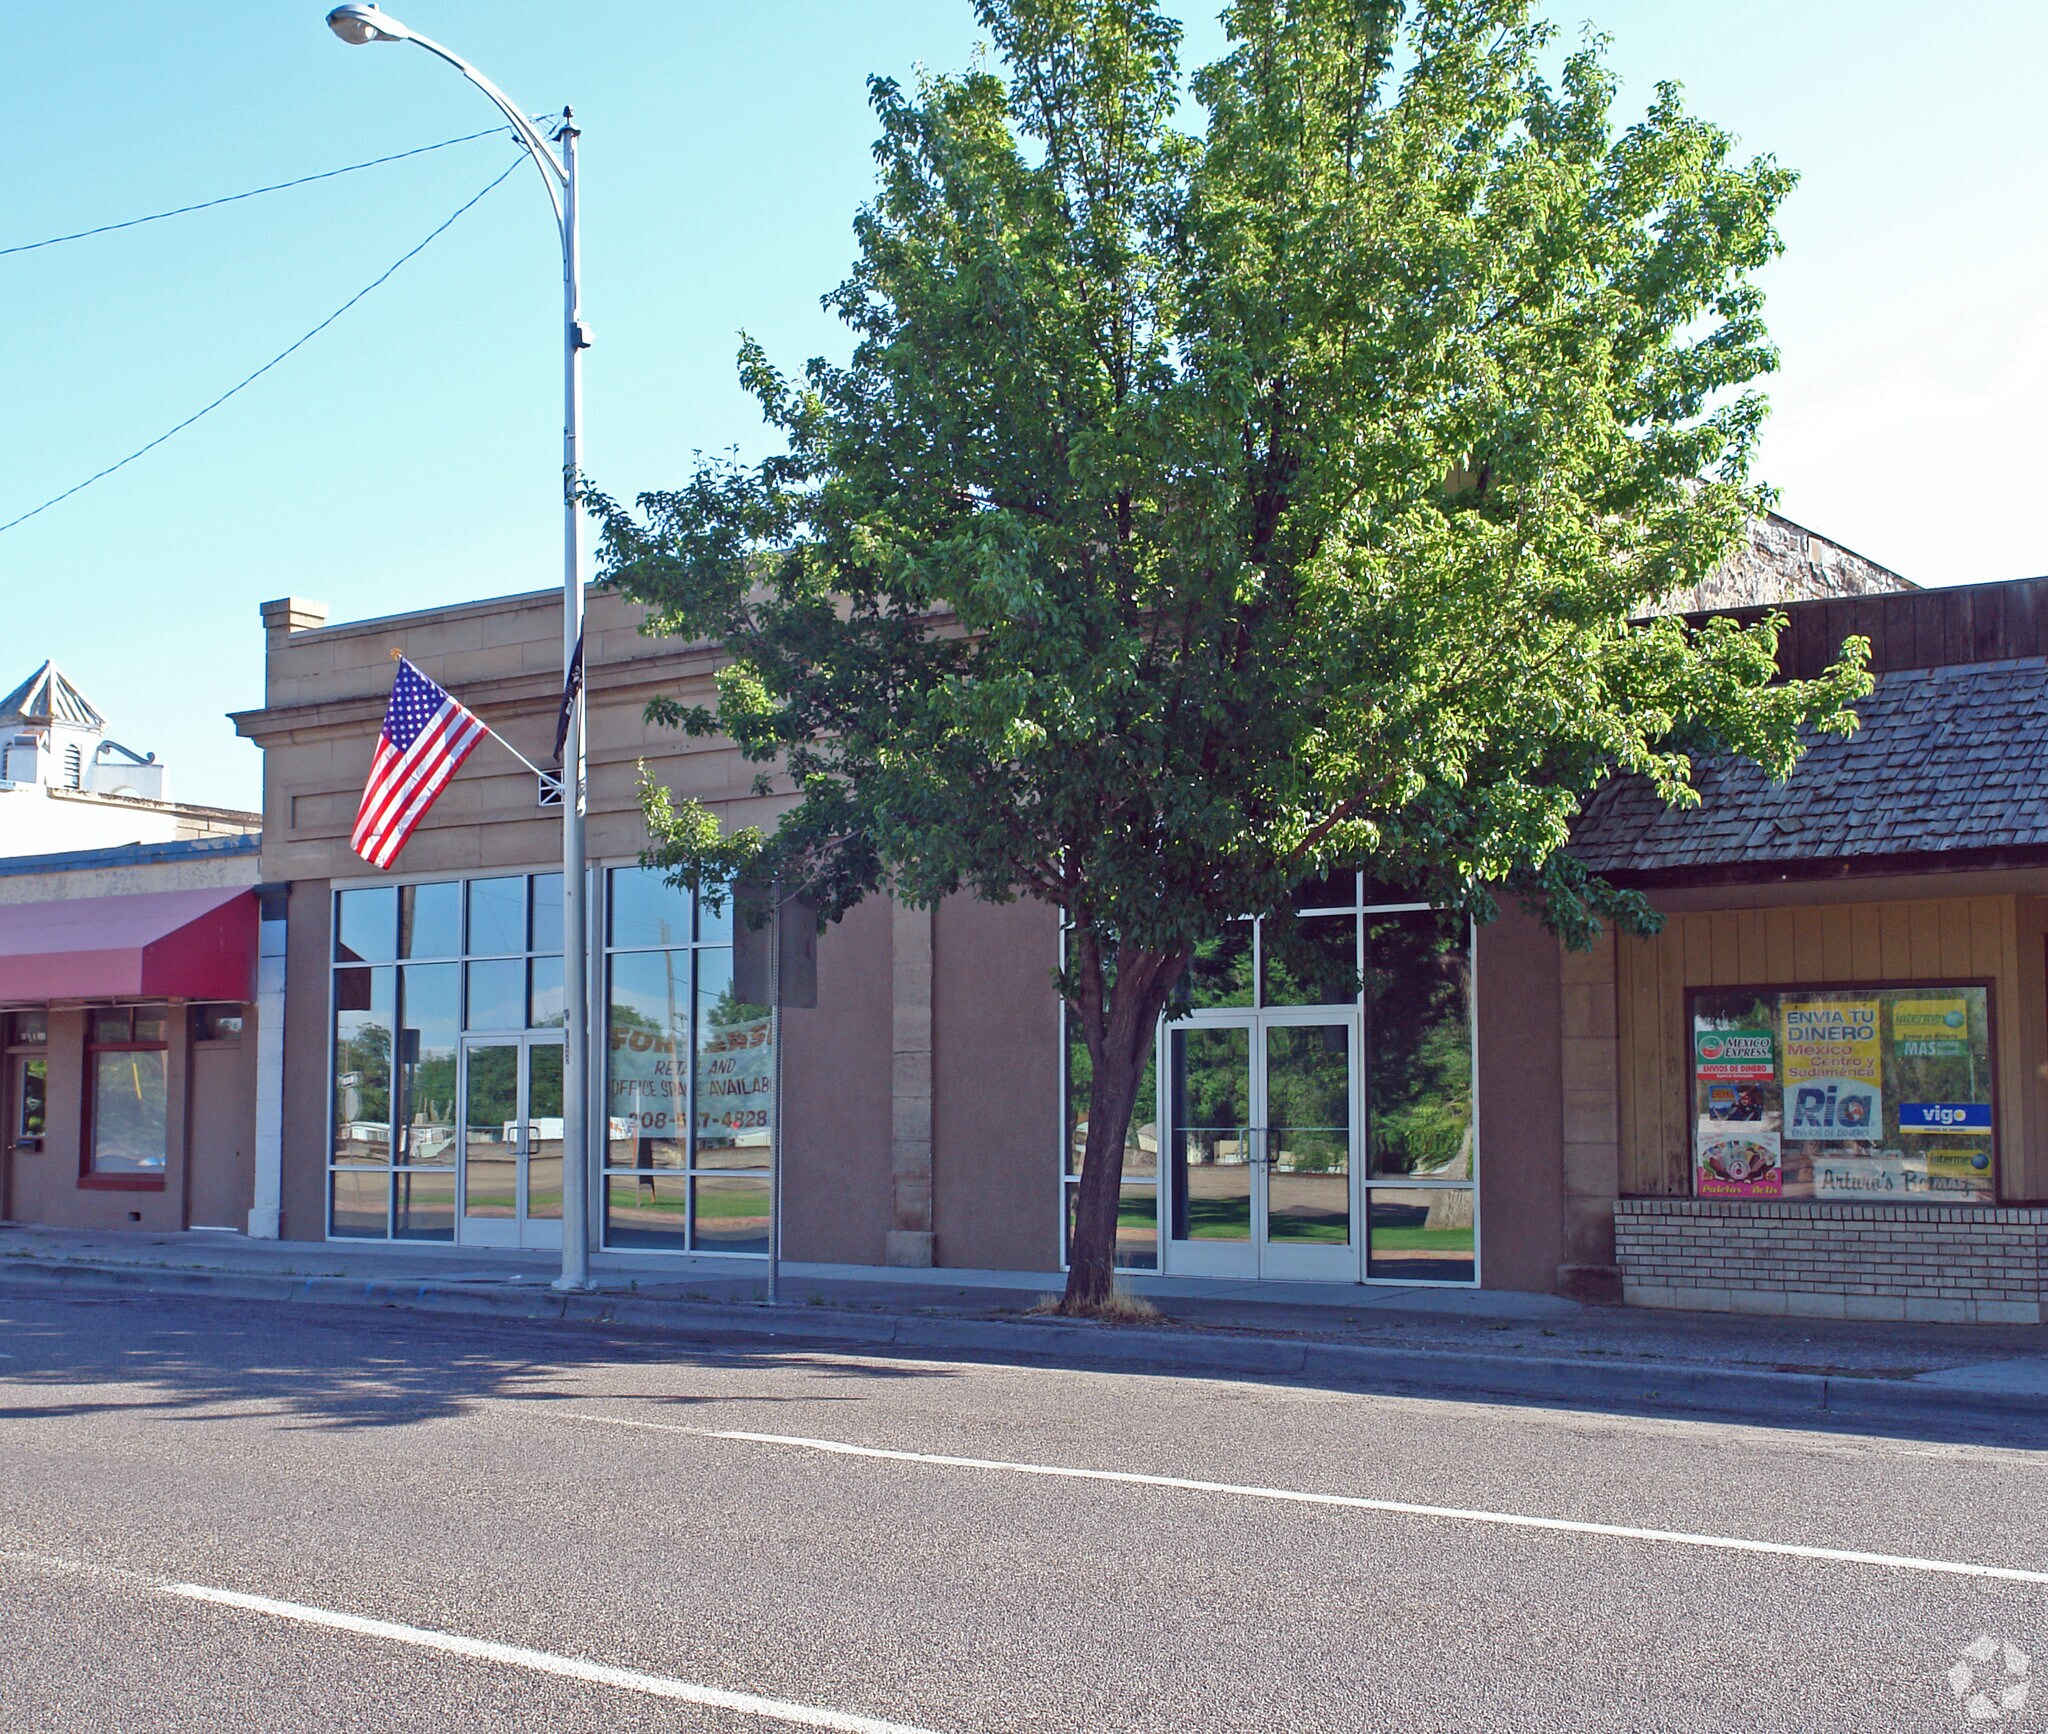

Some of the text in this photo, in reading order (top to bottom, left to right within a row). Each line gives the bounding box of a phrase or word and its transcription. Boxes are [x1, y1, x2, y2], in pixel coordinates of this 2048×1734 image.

[1787, 1010, 1875, 1024] ENVIA TU
[1788, 1026, 1875, 1041] DINERO
[1727, 1037, 1770, 1048] MEXICO
[1904, 1041, 1936, 1056] MAS
[1725, 1047, 1767, 1057] EXPRESS
[708, 1058, 736, 1074] AND
[1811, 1057, 1875, 1067] Centro y
[611, 1079, 657, 1097] OFFICE
[1793, 1086, 1872, 1127] Ria
[1923, 1105, 1966, 1124] vigo
[1822, 1168, 1893, 1191] Arturo's
